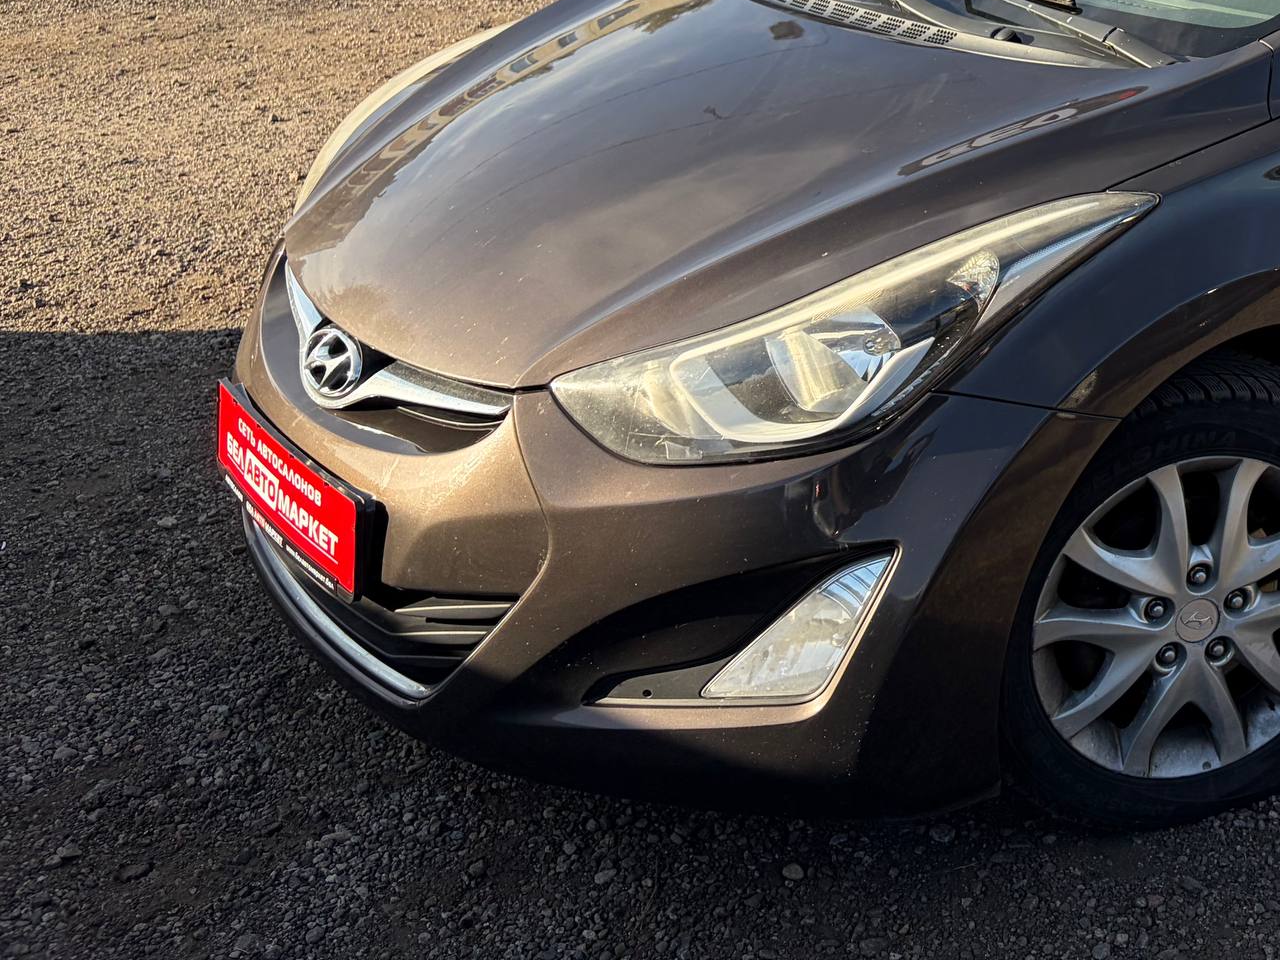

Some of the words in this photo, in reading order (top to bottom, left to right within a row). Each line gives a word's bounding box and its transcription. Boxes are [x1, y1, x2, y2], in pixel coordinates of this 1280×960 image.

[226, 433, 245, 470] БЕЛ
[246, 460, 276, 503] АВТО
[278, 488, 339, 556] МАРКЕТ
[237, 417, 256, 445] СЕТЬ
[256, 439, 322, 507] АВТОСАЛОНОВ
